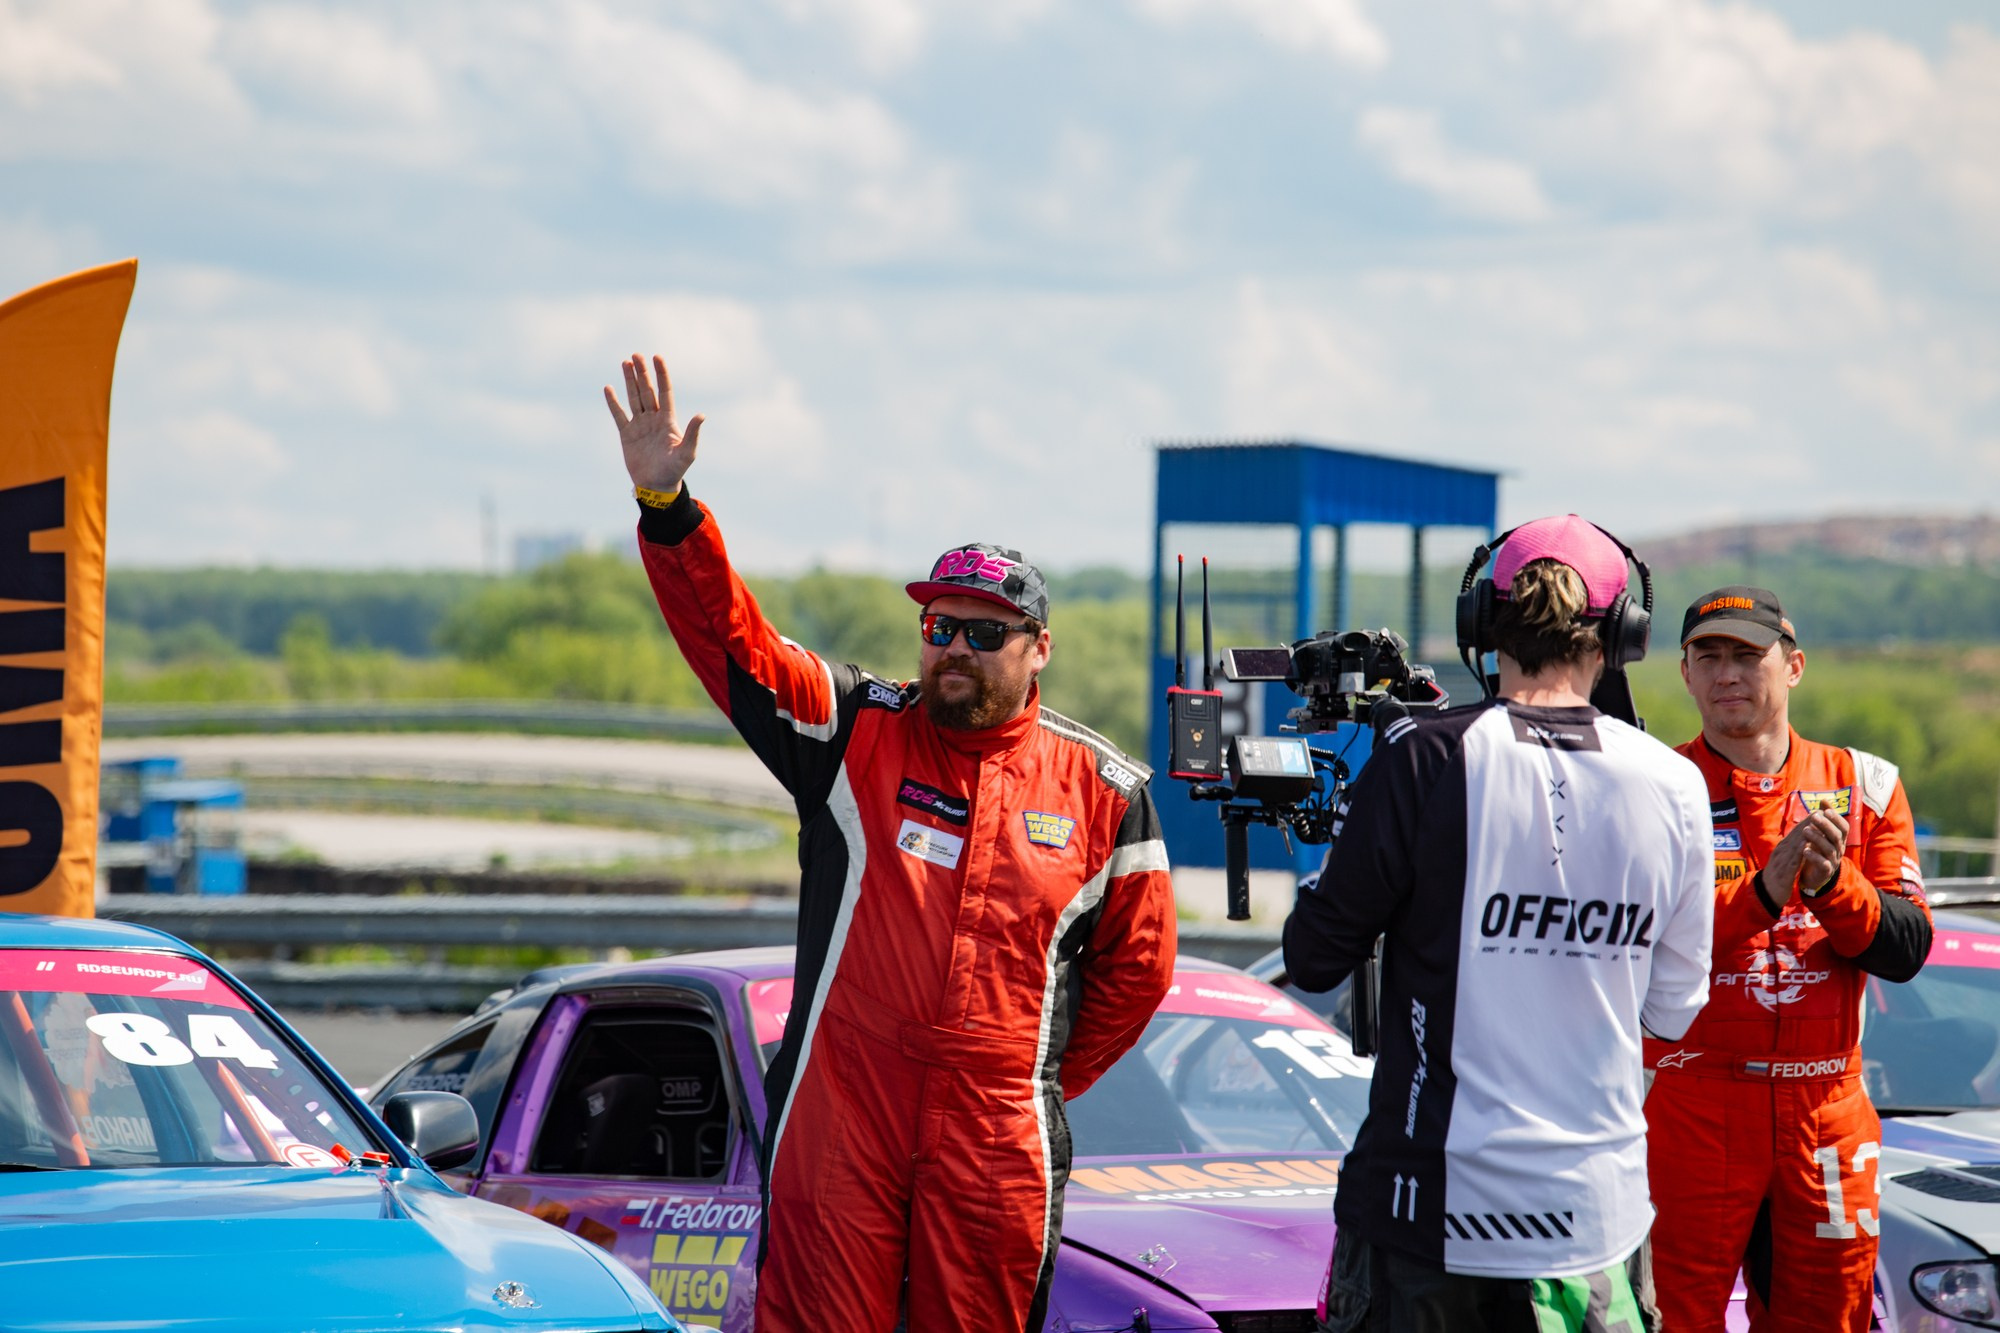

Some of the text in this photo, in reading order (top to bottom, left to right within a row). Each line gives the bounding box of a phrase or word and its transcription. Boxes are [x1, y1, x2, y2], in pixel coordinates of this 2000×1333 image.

[933, 549, 1022, 583] RDS
[1699, 596, 1753, 616] MASUMA
[868, 686, 900, 705] OMP
[1103, 763, 1136, 788] OMP
[900, 785, 938, 805] RDS
[1027, 821, 1071, 840] WEGO
[77, 963, 202, 984] RDSEUROPE.RU
[86, 1013, 280, 1070] 84
[1252, 1029, 1376, 1079] 13
[1771, 1057, 1847, 1078] FEDOROV
[662, 1082, 702, 1098] OMP
[1405, 1081, 1421, 1140] EUROPE
[650, 1268, 729, 1310] WEGO
